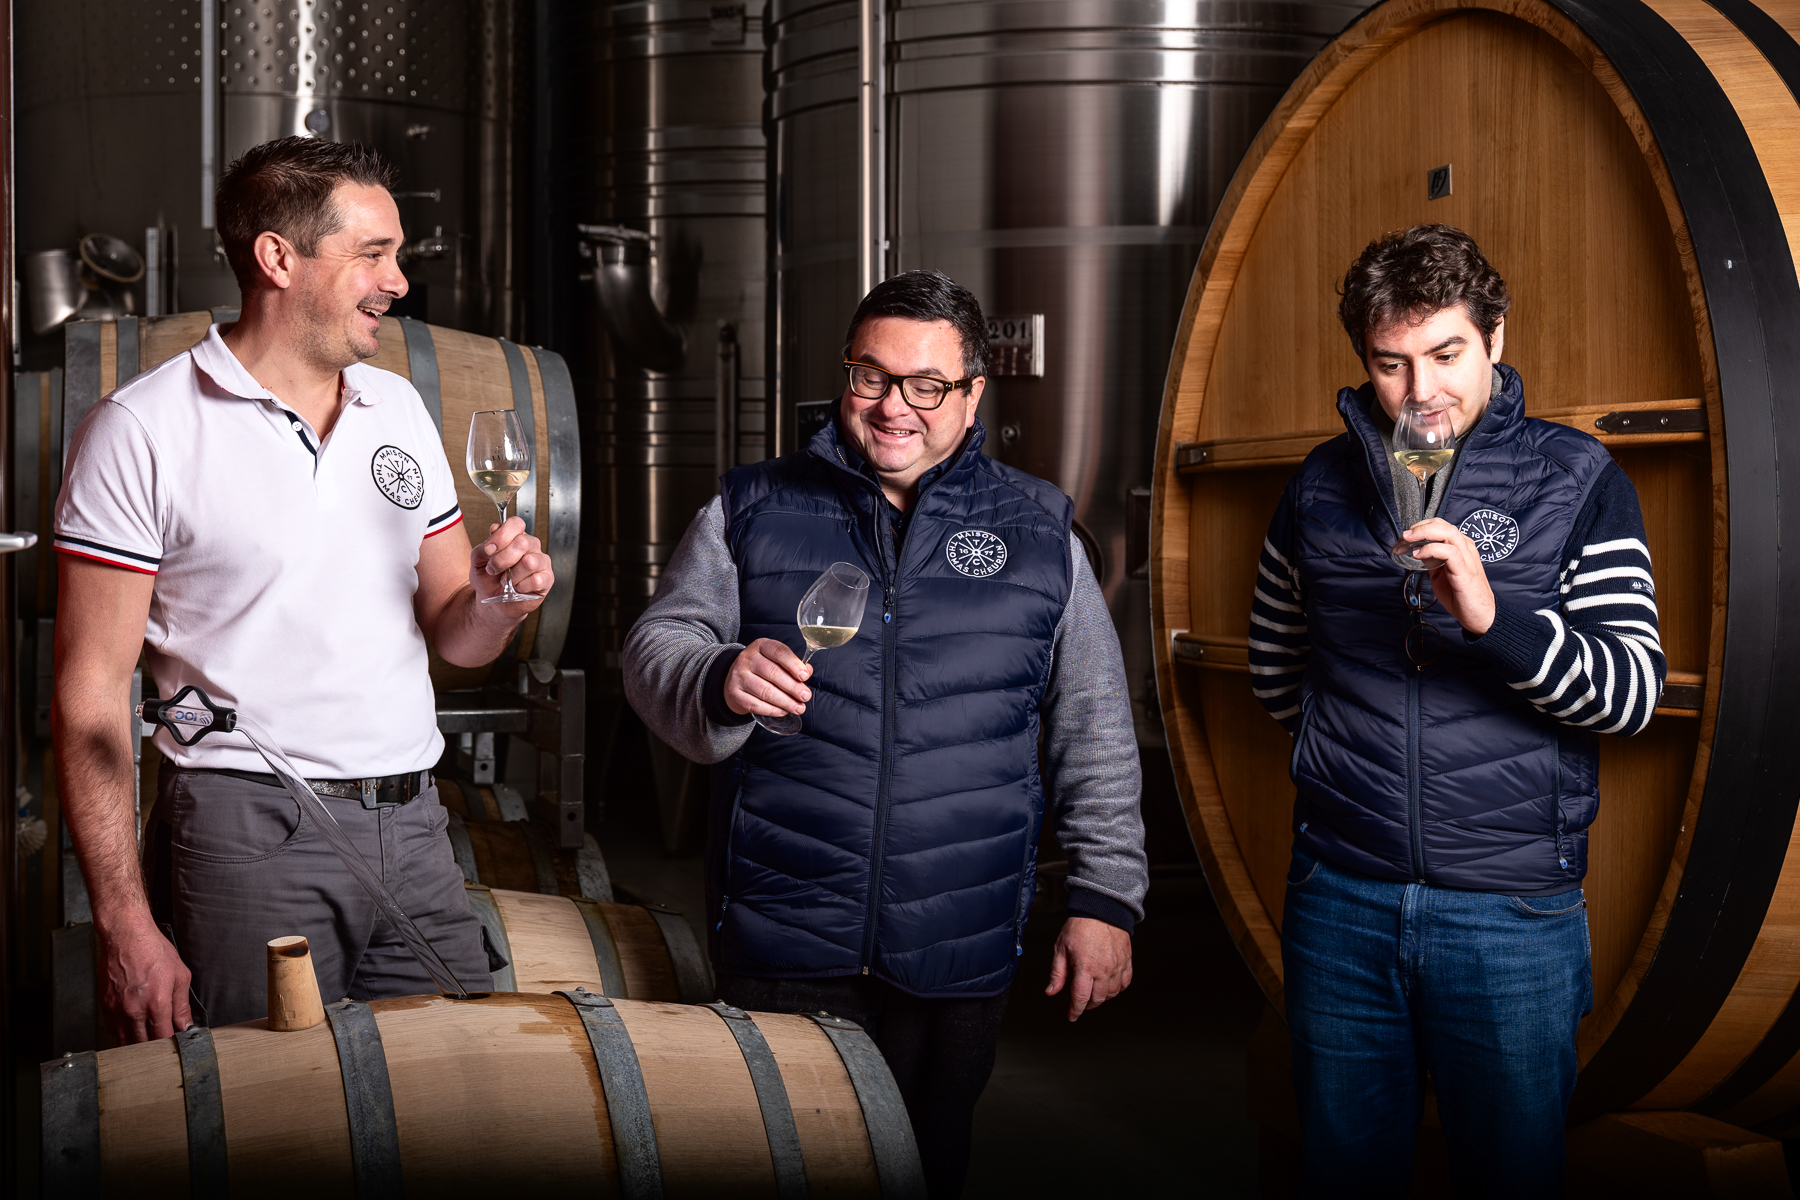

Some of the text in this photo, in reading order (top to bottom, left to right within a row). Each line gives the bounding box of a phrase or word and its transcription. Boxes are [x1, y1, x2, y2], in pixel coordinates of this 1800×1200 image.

[379, 449, 410, 464] MAISON
[376, 463, 422, 505] THOMAS CHEURLIN
[1473, 511, 1512, 526] MAISON
[1487, 522, 1496, 532] T
[956, 531, 997, 542] MAISON
[1480, 526, 1517, 561] CHEURLIN
[949, 541, 1005, 575] THOMAS CHEURLIN
